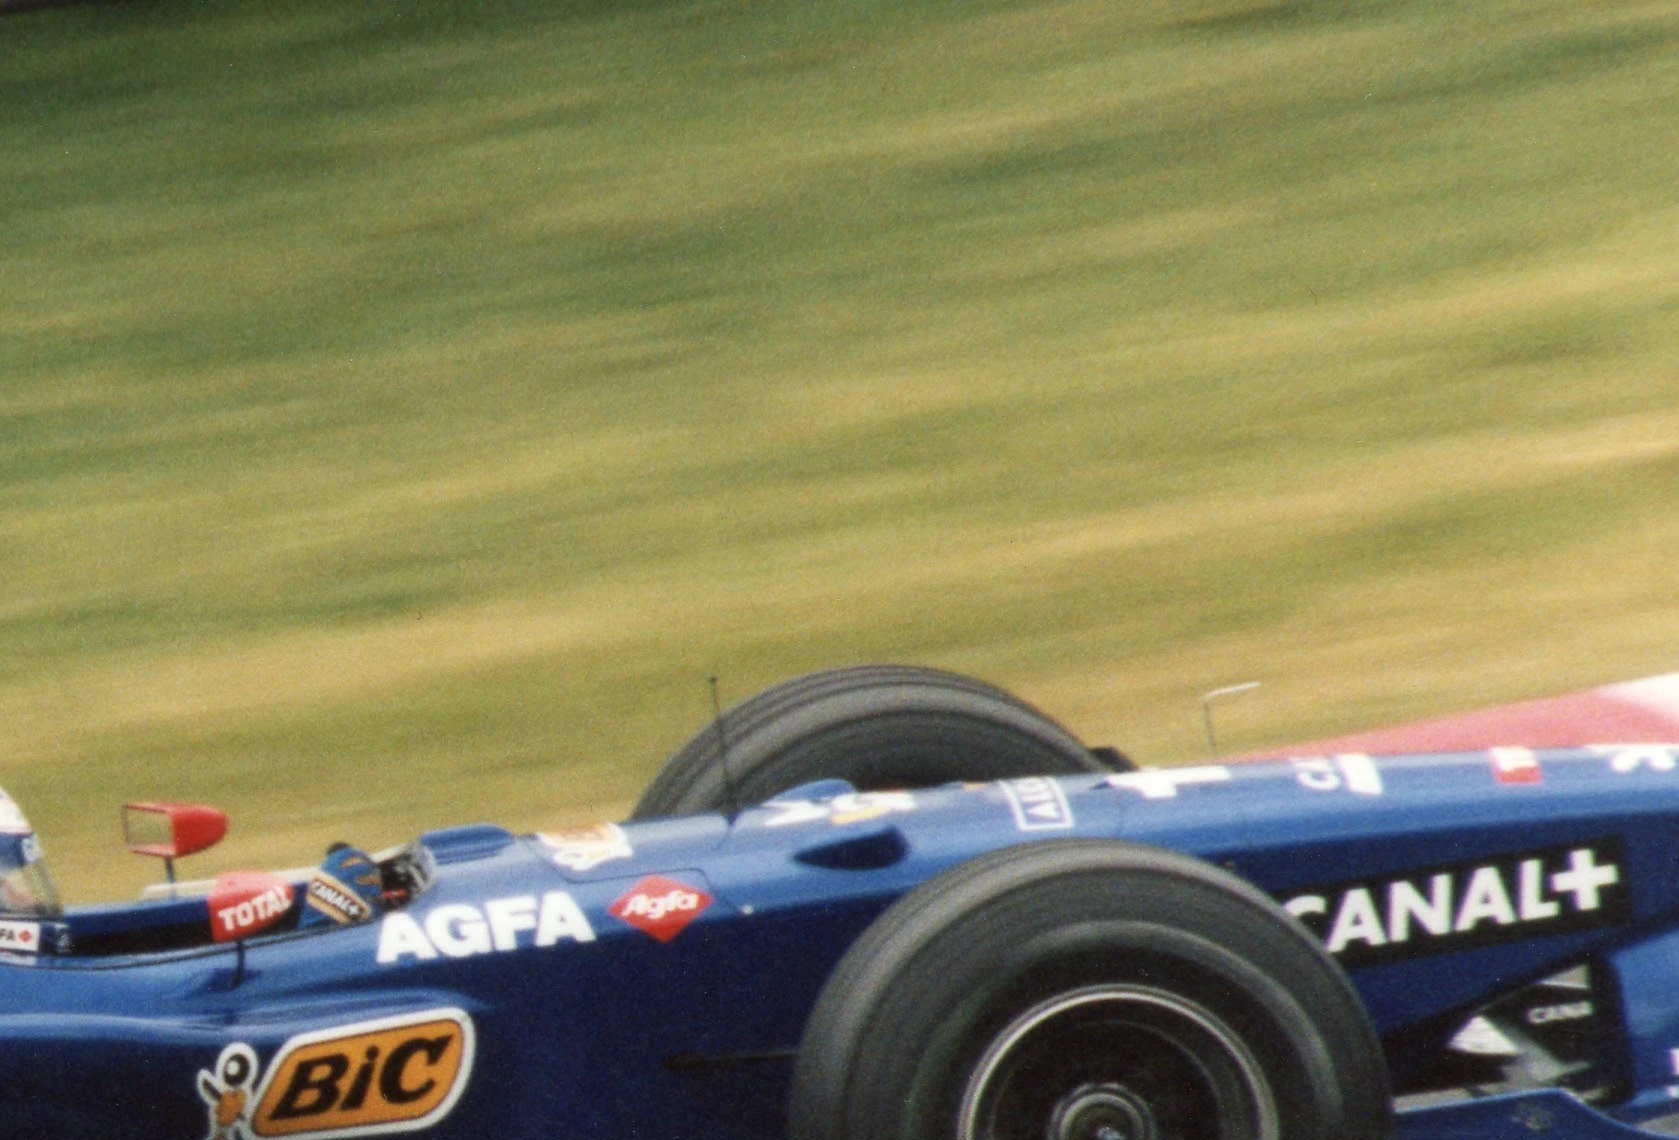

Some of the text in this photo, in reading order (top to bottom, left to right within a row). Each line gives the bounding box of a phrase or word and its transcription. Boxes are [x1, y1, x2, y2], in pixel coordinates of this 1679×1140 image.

[218, 884, 292, 931] TOTAL
[375, 891, 596, 964] AGFA
[621, 889, 699, 919] Agfa
